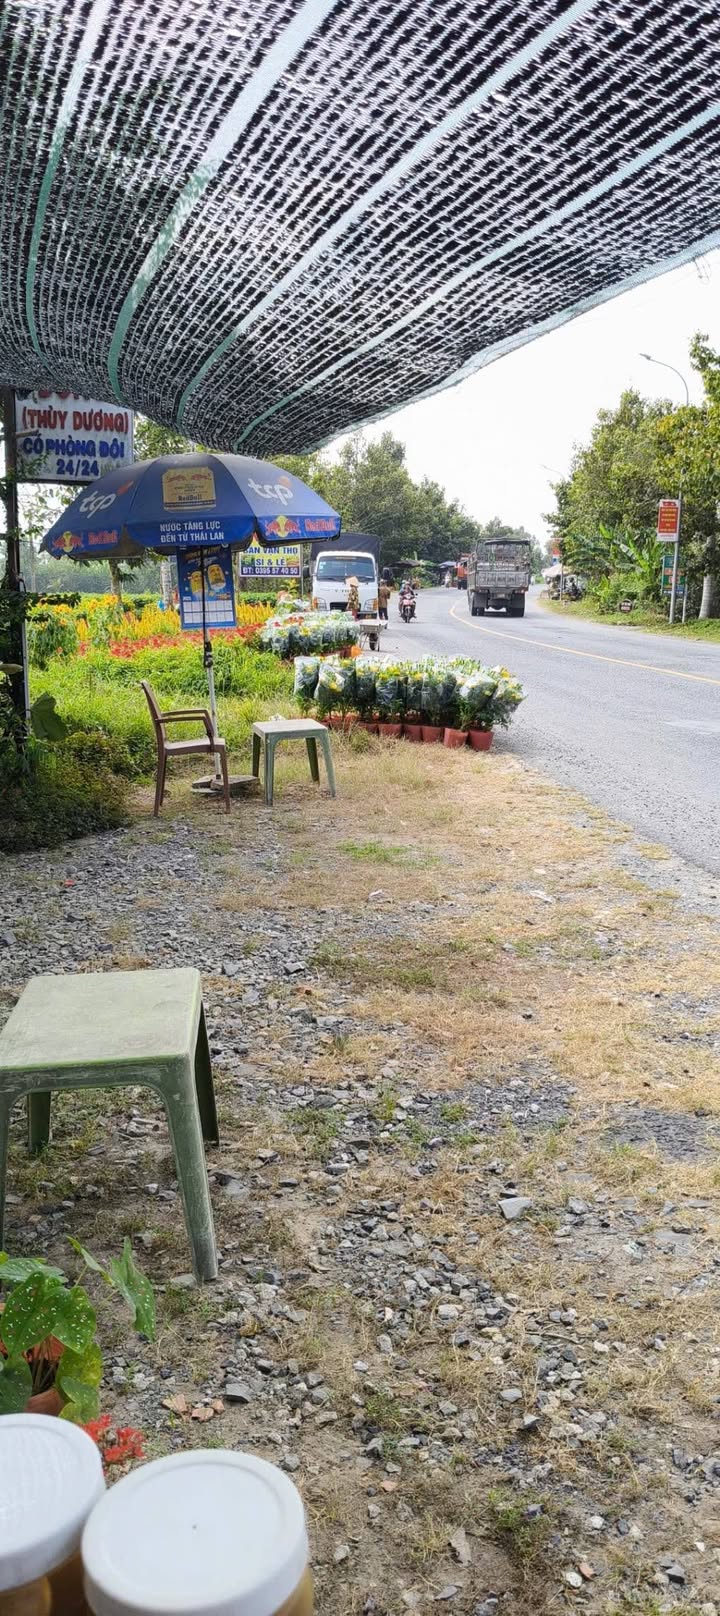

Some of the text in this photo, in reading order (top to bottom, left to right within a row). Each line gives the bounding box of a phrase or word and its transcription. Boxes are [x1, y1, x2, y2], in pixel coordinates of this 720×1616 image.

[22, 405, 129, 434] (THỦY DƯƠNG)
[45, 434, 96, 457] PHÒNG
[56, 458, 100, 477] 24/24
[247, 478, 293, 506] tcp
[79, 490, 116, 519] tcp
[209, 531, 224, 541] LAN
[267, 558, 273, 566] &
[280, 567, 289, 575] 40
[290, 567, 298, 575] 50
